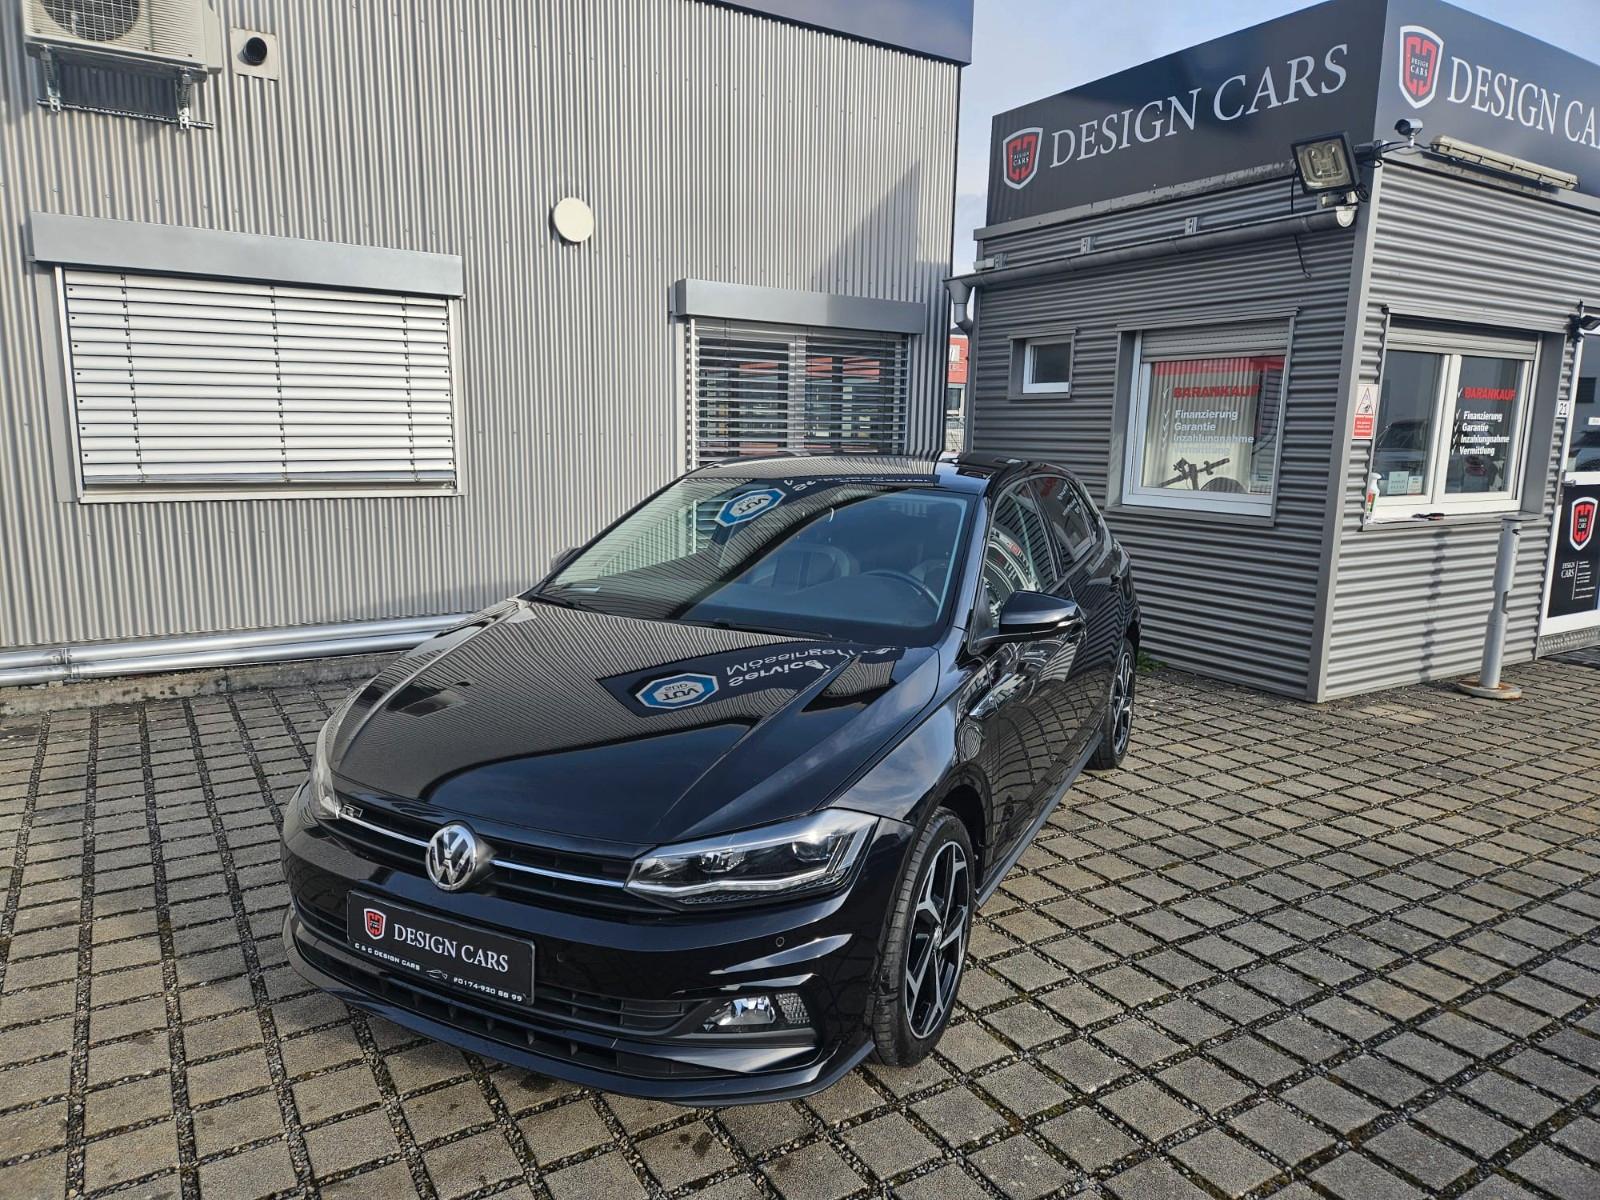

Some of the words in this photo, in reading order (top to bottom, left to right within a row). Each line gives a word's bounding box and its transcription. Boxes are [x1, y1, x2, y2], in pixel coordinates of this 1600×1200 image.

[1050, 88, 1202, 168] DESIGN
[1213, 44, 1348, 121] CARS
[1447, 56, 1561, 135] DESIGN
[1564, 100, 1600, 149] CA
[1174, 385, 1260, 398] BARANKAUF
[1464, 387, 1516, 401] BARANKAUF
[1174, 409, 1238, 420] Finanzierung
[1463, 411, 1503, 422] Finanzierung
[1174, 422, 1217, 431] Garantie
[1462, 422, 1489, 432] Garantie
[393, 923, 458, 959] DESIGN
[461, 943, 509, 973] CARS
[374, 949, 400, 963] DESIGN
[401, 959, 421, 971] CARS
[511, 993, 523, 1002] 99
